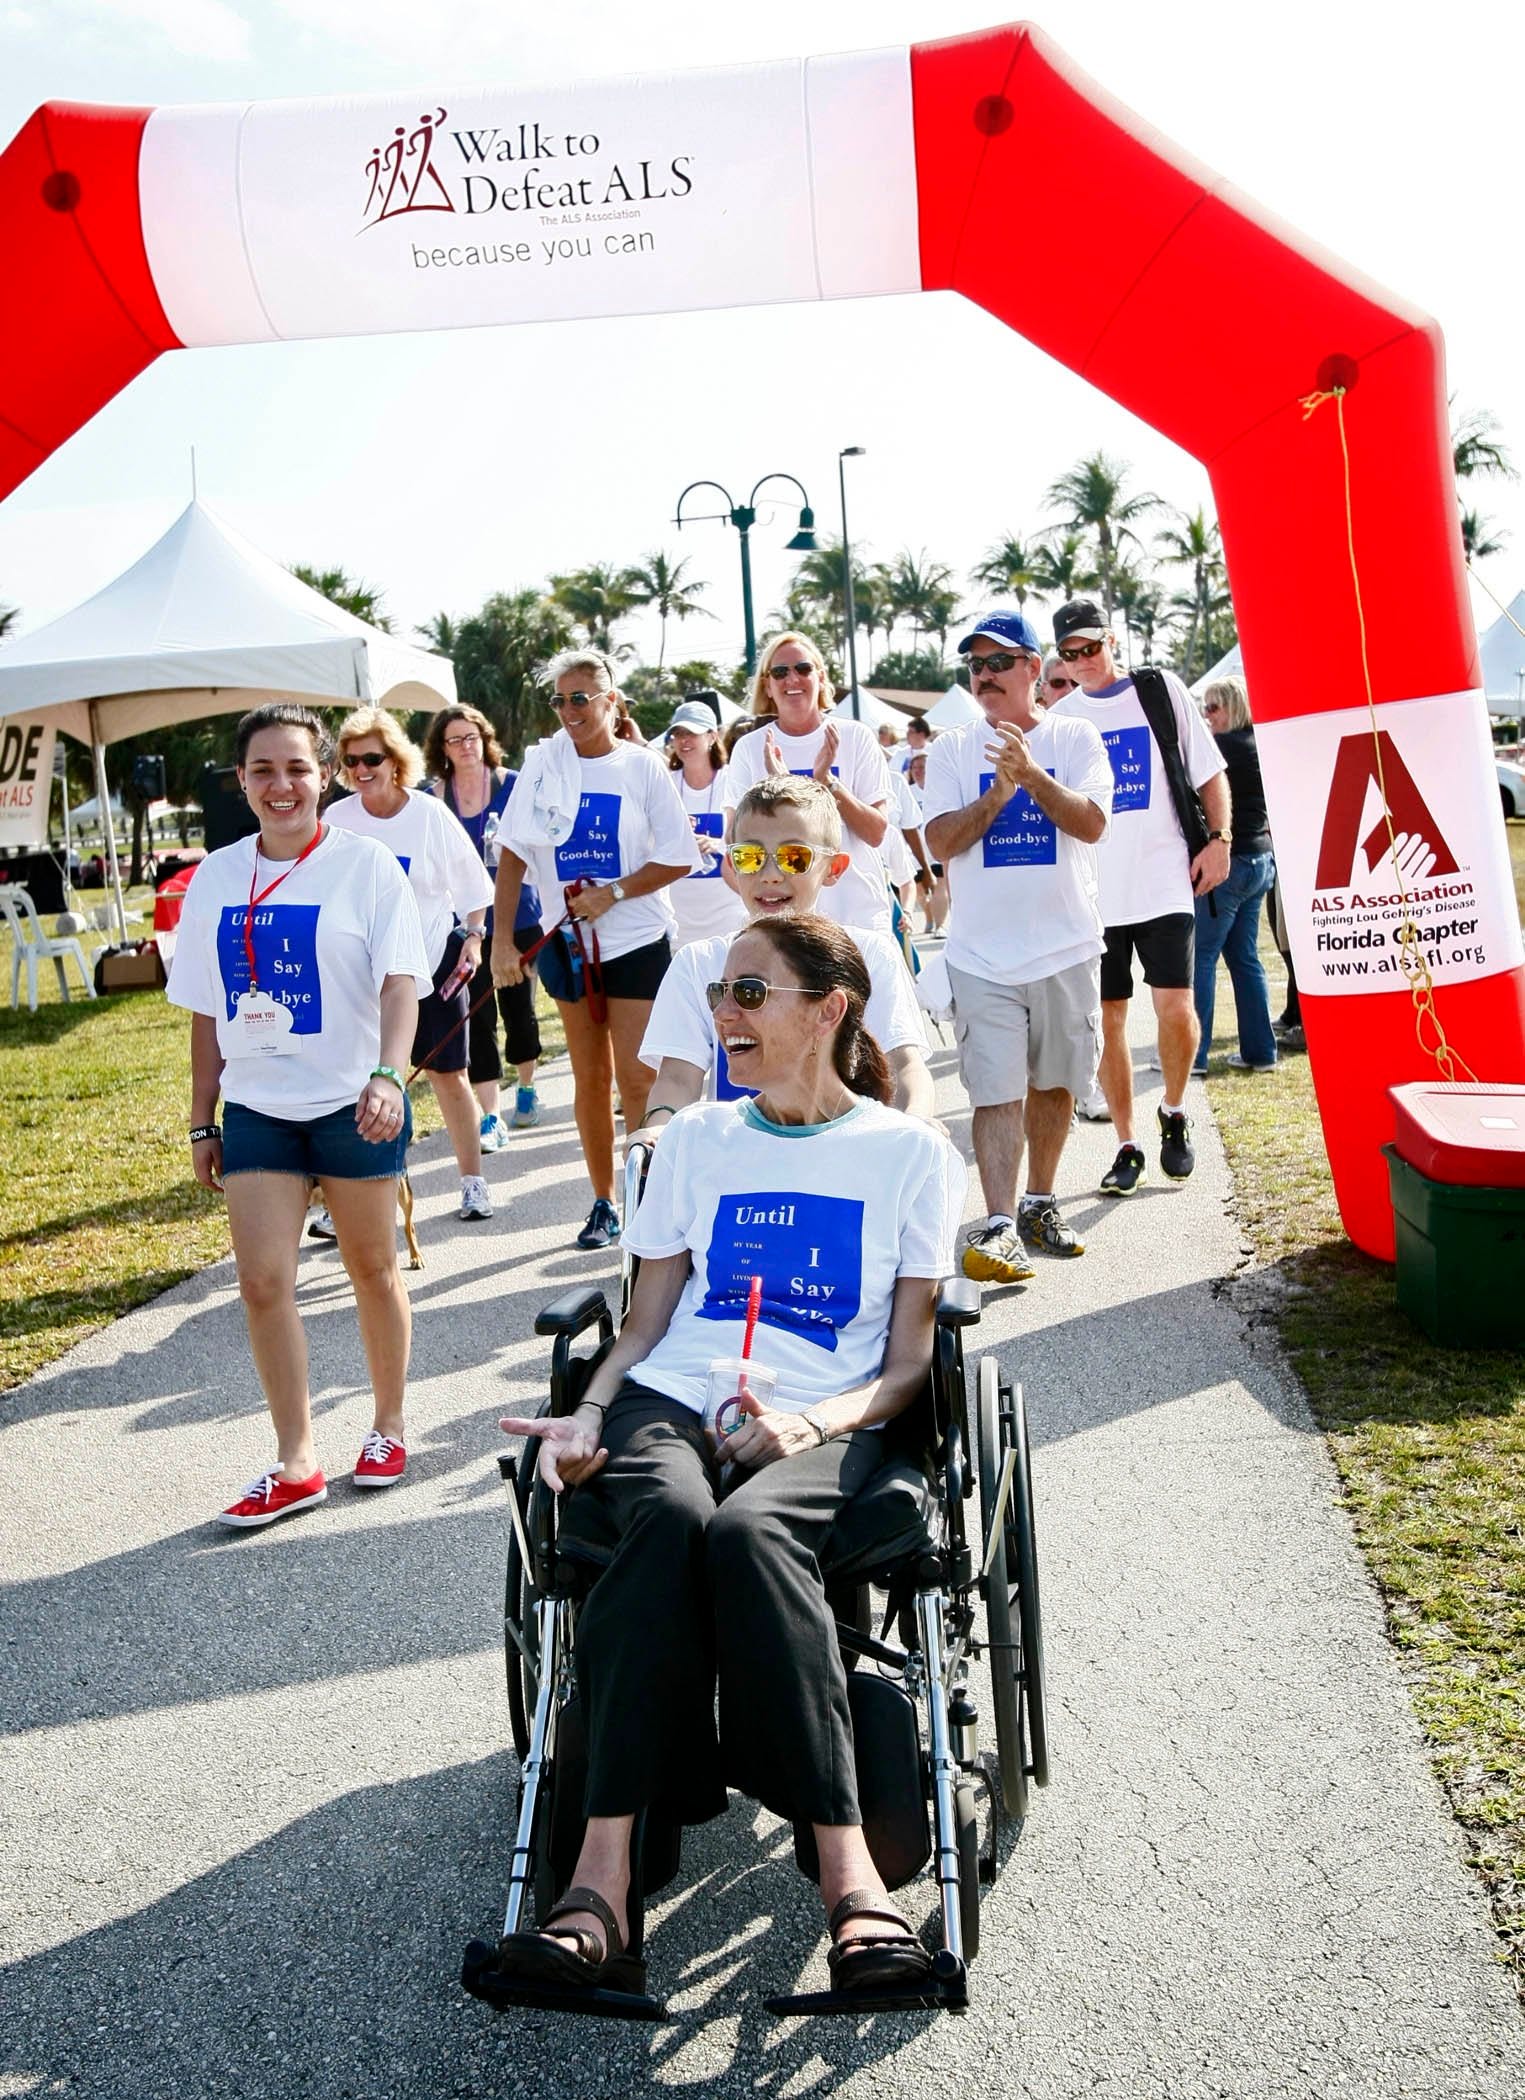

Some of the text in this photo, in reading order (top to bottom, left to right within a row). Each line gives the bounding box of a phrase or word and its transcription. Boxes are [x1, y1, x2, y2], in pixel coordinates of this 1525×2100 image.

[450, 123, 600, 164] Walk to
[460, 156, 693, 214] Defeat ALS
[540, 208, 642, 227] The ALS Association
[412, 231, 655, 270] because you can
[1127, 749, 1133, 759] I
[1121, 763, 1141, 775] Say
[9, 785, 34, 807] ALS
[595, 815, 601, 826] I
[1021, 810, 1043, 824] Say
[588, 830, 608, 843] Say
[989, 832, 1049, 847] Good-bye
[559, 849, 614, 863] Good-bye
[1311, 881, 1474, 913] ALS Association
[1312, 898, 1476, 928] Fighting Lou Gehrig's Disease
[282, 938, 290, 952] I
[1317, 929, 1386, 952] Florida
[273, 959, 302, 978] Say
[244, 1011, 276, 1021] THANK YOU
[735, 1205, 796, 1226] Until
[745, 1242, 763, 1250] YEAR
[808, 1247, 821, 1268] I
[790, 1277, 836, 1301] Say
